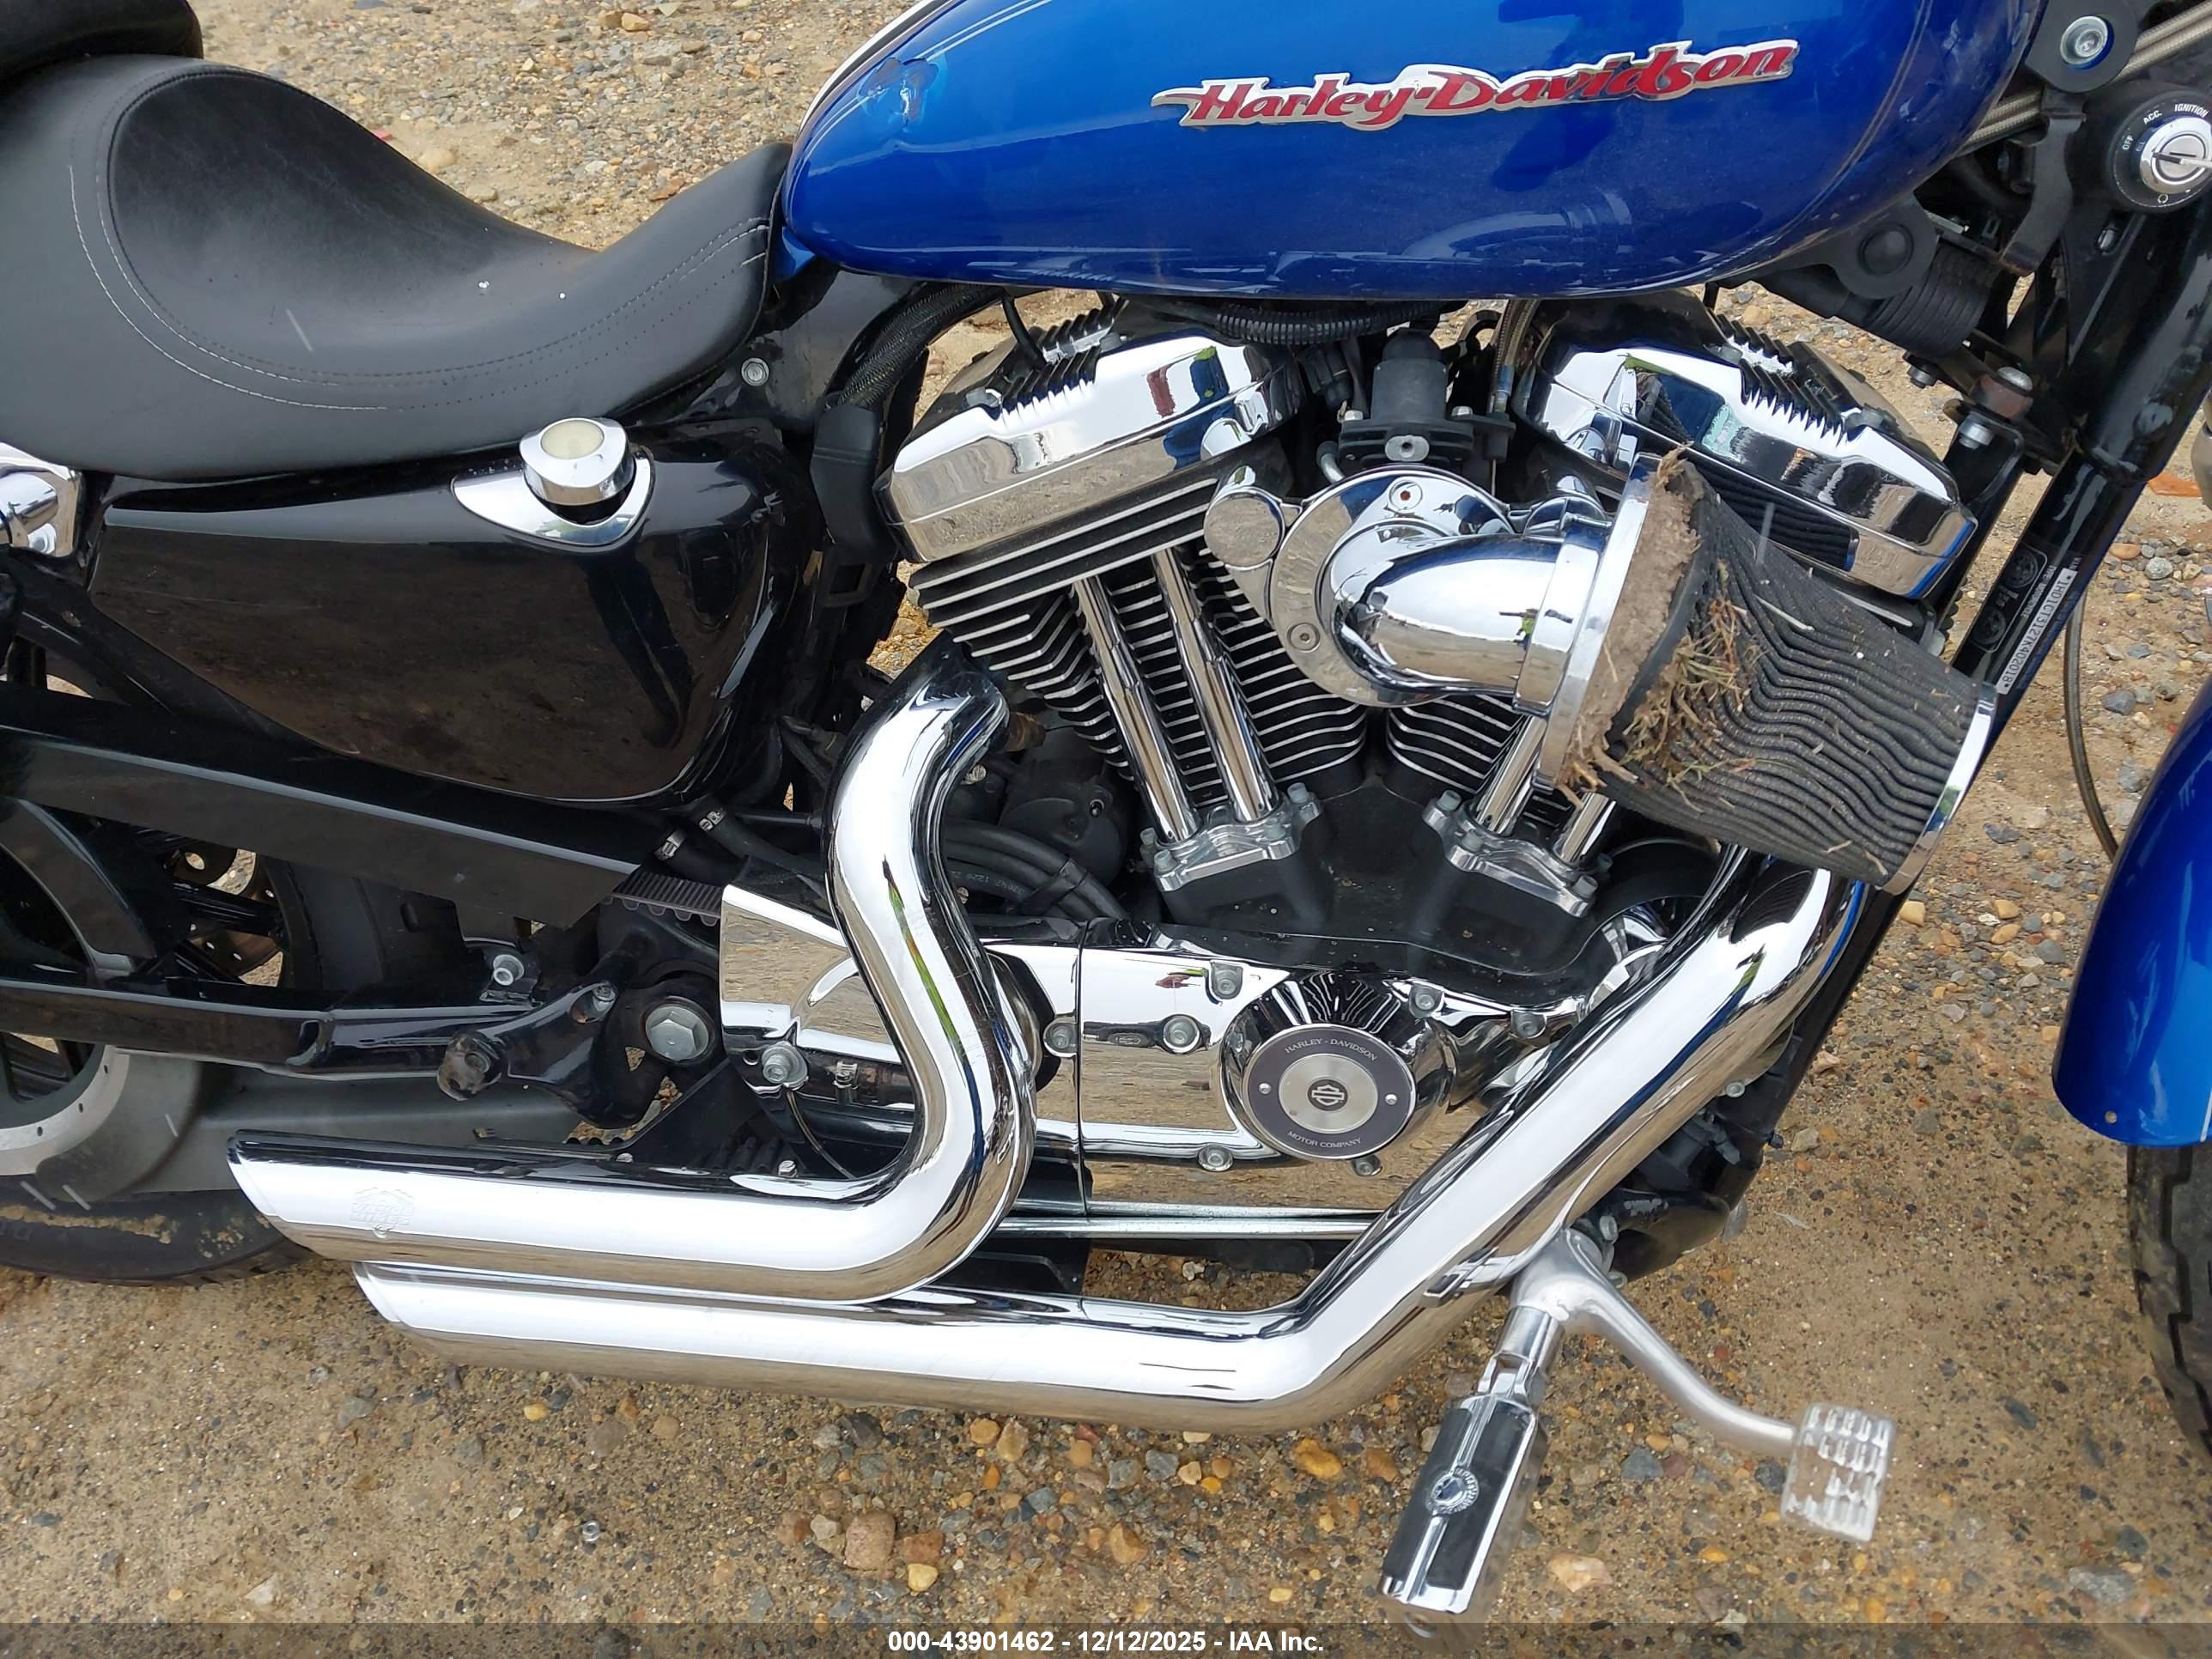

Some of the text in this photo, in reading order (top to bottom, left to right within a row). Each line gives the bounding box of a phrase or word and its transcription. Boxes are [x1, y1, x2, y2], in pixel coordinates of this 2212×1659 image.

[1156, 41, 1798, 129] Harley-Davidson
[2173, 103, 2209, 118] IGNITION
[2122, 135, 2134, 150] OFF
[1285, 1038, 1323, 1054] HARLEY
[1330, 1038, 1378, 1061] DAVIDSON
[1287, 1130, 1363, 1149] MOTOR COMPANY
